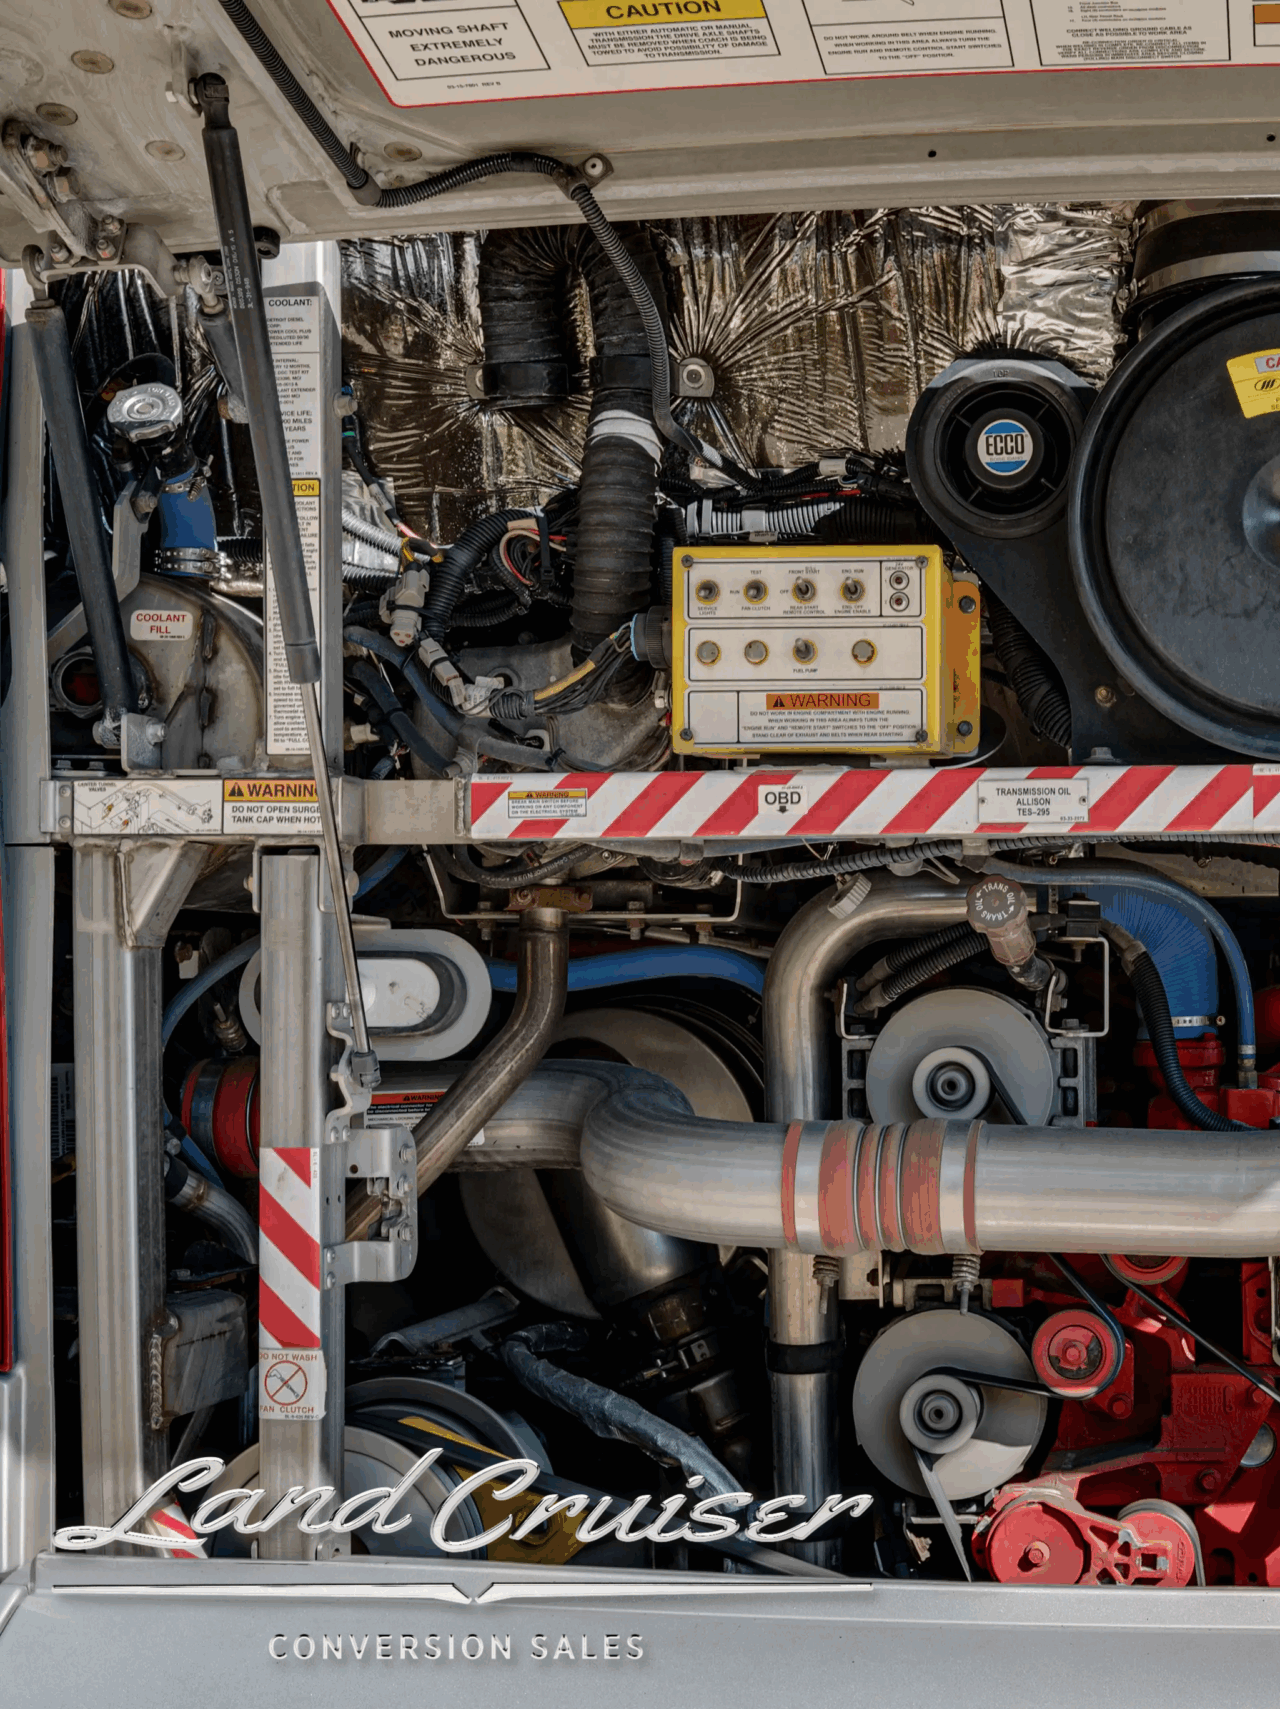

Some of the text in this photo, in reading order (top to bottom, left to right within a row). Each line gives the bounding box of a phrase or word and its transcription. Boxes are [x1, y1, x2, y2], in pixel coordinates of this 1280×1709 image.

[606, 0, 721, 19] CAUTION
[388, 22, 508, 38] MOVING SHAFT
[589, 34, 654, 44] TRANSMISSION
[672, 32, 701, 40] DRIVE
[725, 29, 760, 37] SHAFTS
[615, 28, 649, 36] EITHER
[648, 26, 699, 34] AUTOMATIC
[714, 23, 752, 31] MANUAL
[410, 38, 503, 52] EXTREMELY
[592, 48, 623, 56] TOWED
[636, 46, 663, 54] AVOID
[662, 44, 716, 52] POSSIBILITY
[730, 41, 768, 49] DAMAGE
[626, 40, 670, 48] REMOVED
[670, 38, 697, 46] WHEN
[414, 52, 516, 66] DANGEROUS
[268, 298, 313, 307] COOLANT:
[985, 434, 1025, 456] ECCO
[136, 613, 187, 622] COOLANT
[150, 625, 171, 634] FILL
[789, 694, 871, 708] WARNING
[996, 787, 1071, 796] TRANSMISSION OIL
[764, 792, 801, 806] OBD
[1016, 797, 1051, 806] ALLISON
[232, 805, 321, 814] DO NOT OPEN SURGE
[1017, 808, 1051, 816] TES-295
[232, 816, 254, 824] TANK
[256, 816, 274, 824] CAP
[276, 816, 301, 824] WHEN
[982, 882, 1016, 905] TRANS OIL
[975, 898, 1008, 921] TRANS OIL
